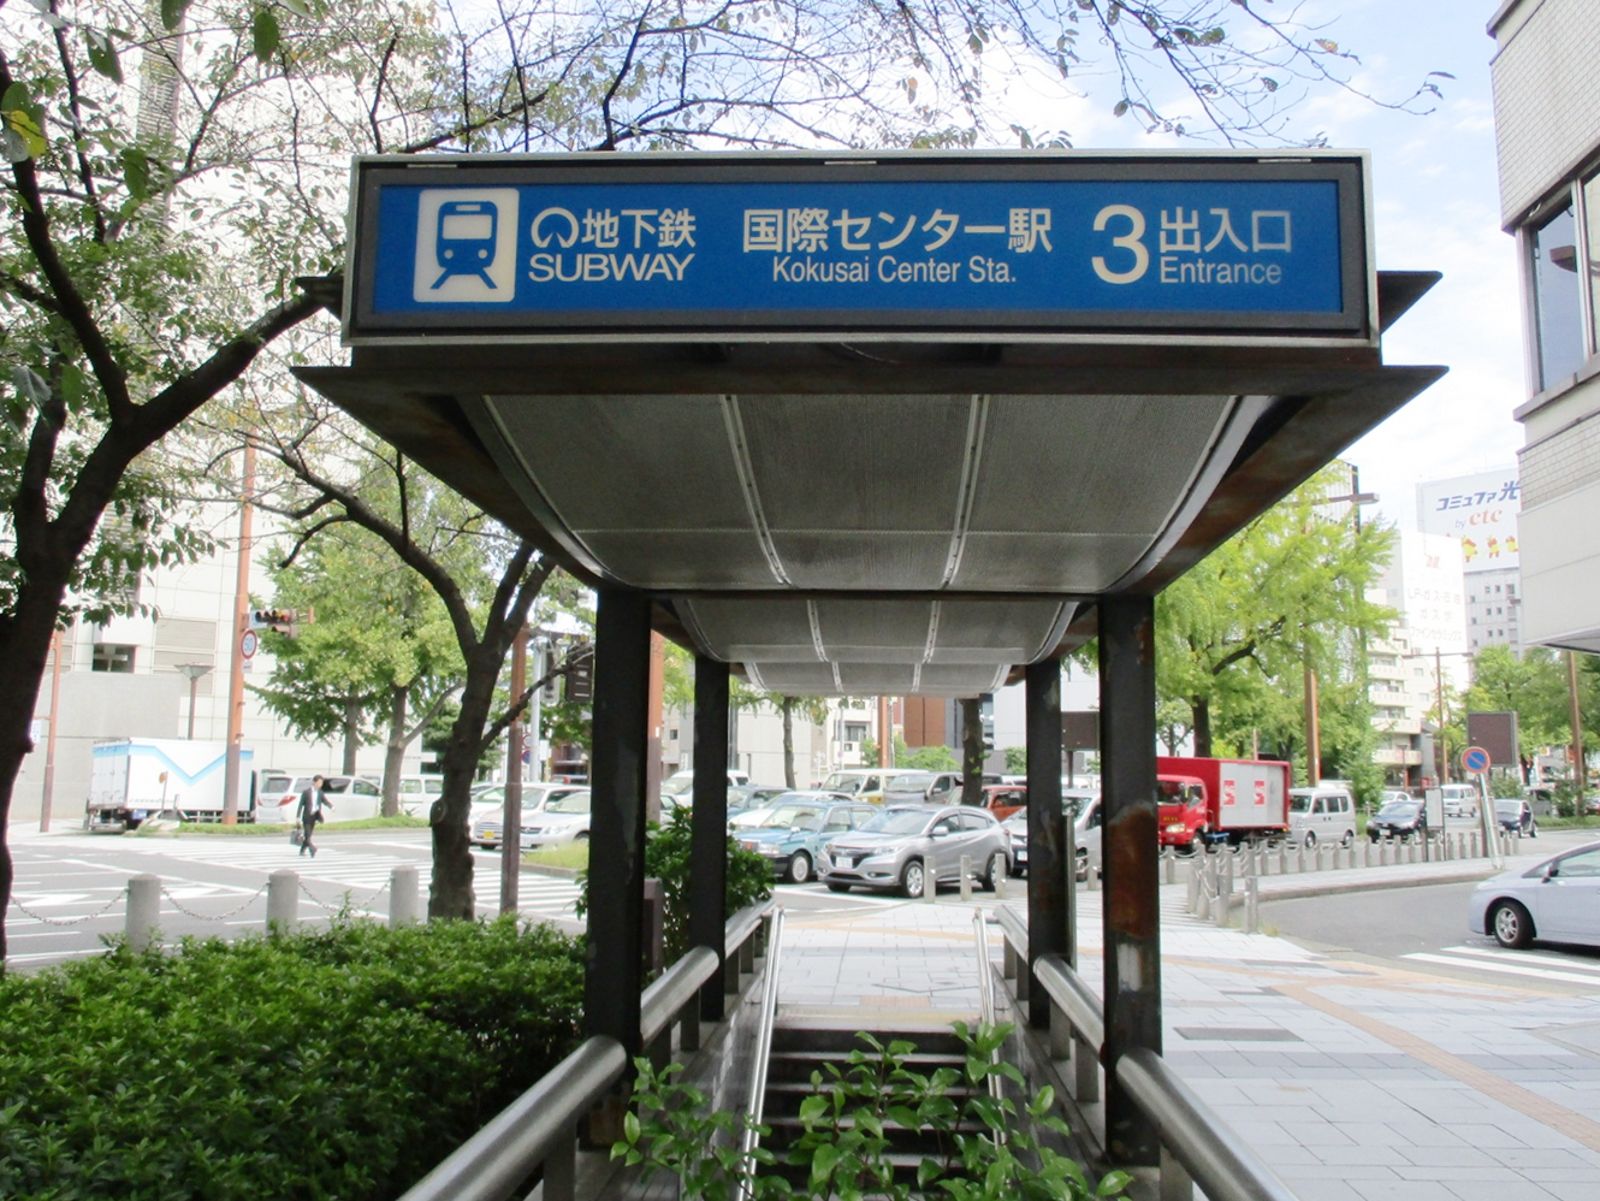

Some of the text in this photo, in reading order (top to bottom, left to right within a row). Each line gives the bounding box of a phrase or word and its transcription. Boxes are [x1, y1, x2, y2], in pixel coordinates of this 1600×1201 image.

[581, 208, 697, 249] 地下鉄
[742, 207, 1053, 254] 国際センター駅
[1091, 204, 1150, 285] 3
[1159, 206, 1292, 253] 出入口
[528, 253, 695, 283] SUBWAY
[772, 255, 1018, 284] Kokusai Center Sta.
[1160, 256, 1283, 285] Entrance
